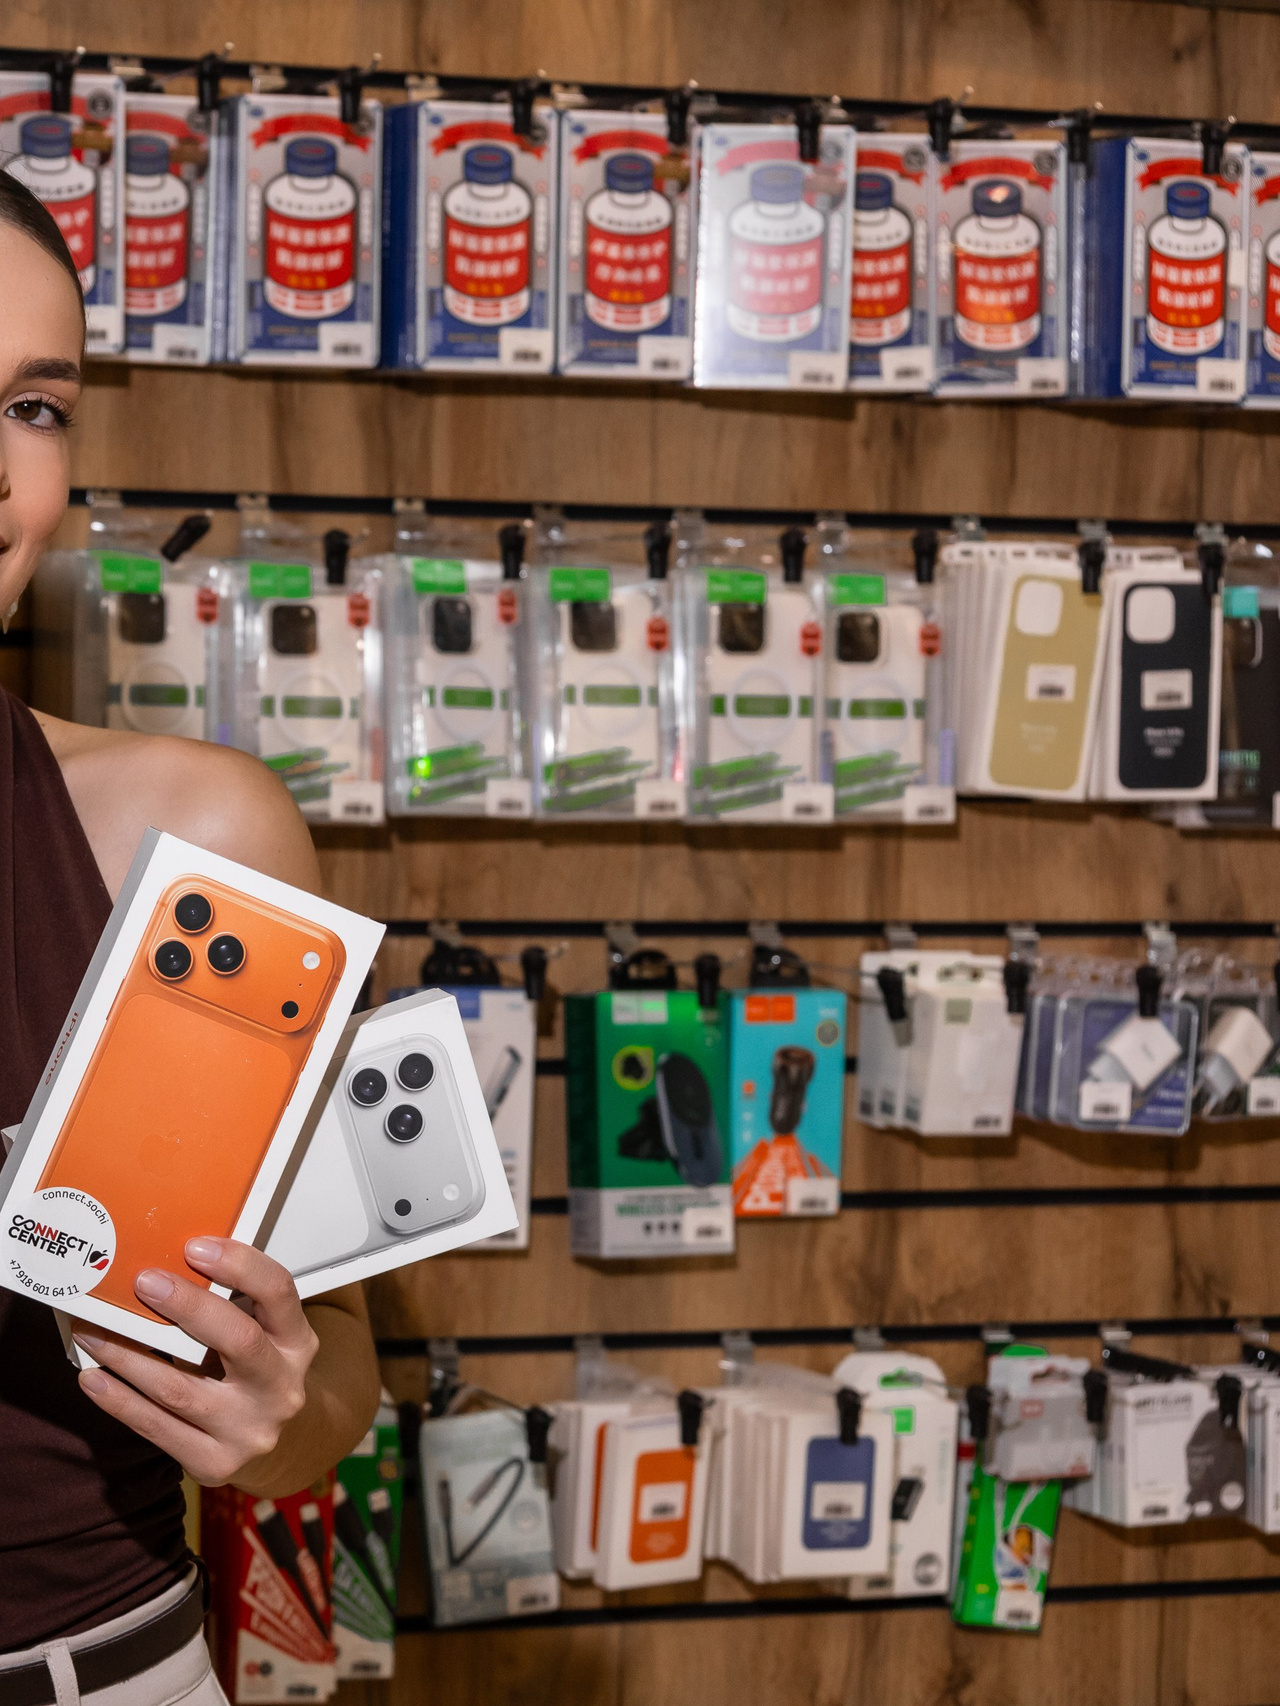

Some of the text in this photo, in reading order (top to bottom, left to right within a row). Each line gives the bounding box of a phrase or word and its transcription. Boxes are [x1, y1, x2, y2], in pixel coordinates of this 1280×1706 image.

[45, 1011, 79, 1086] iPhone
[42, 1190, 109, 1225] connect.sochi
[8, 1226, 68, 1258] CENTER
[12, 1214, 88, 1252] CONNECT
[10, 1259, 80, 1297] +7 918 601 64 11
